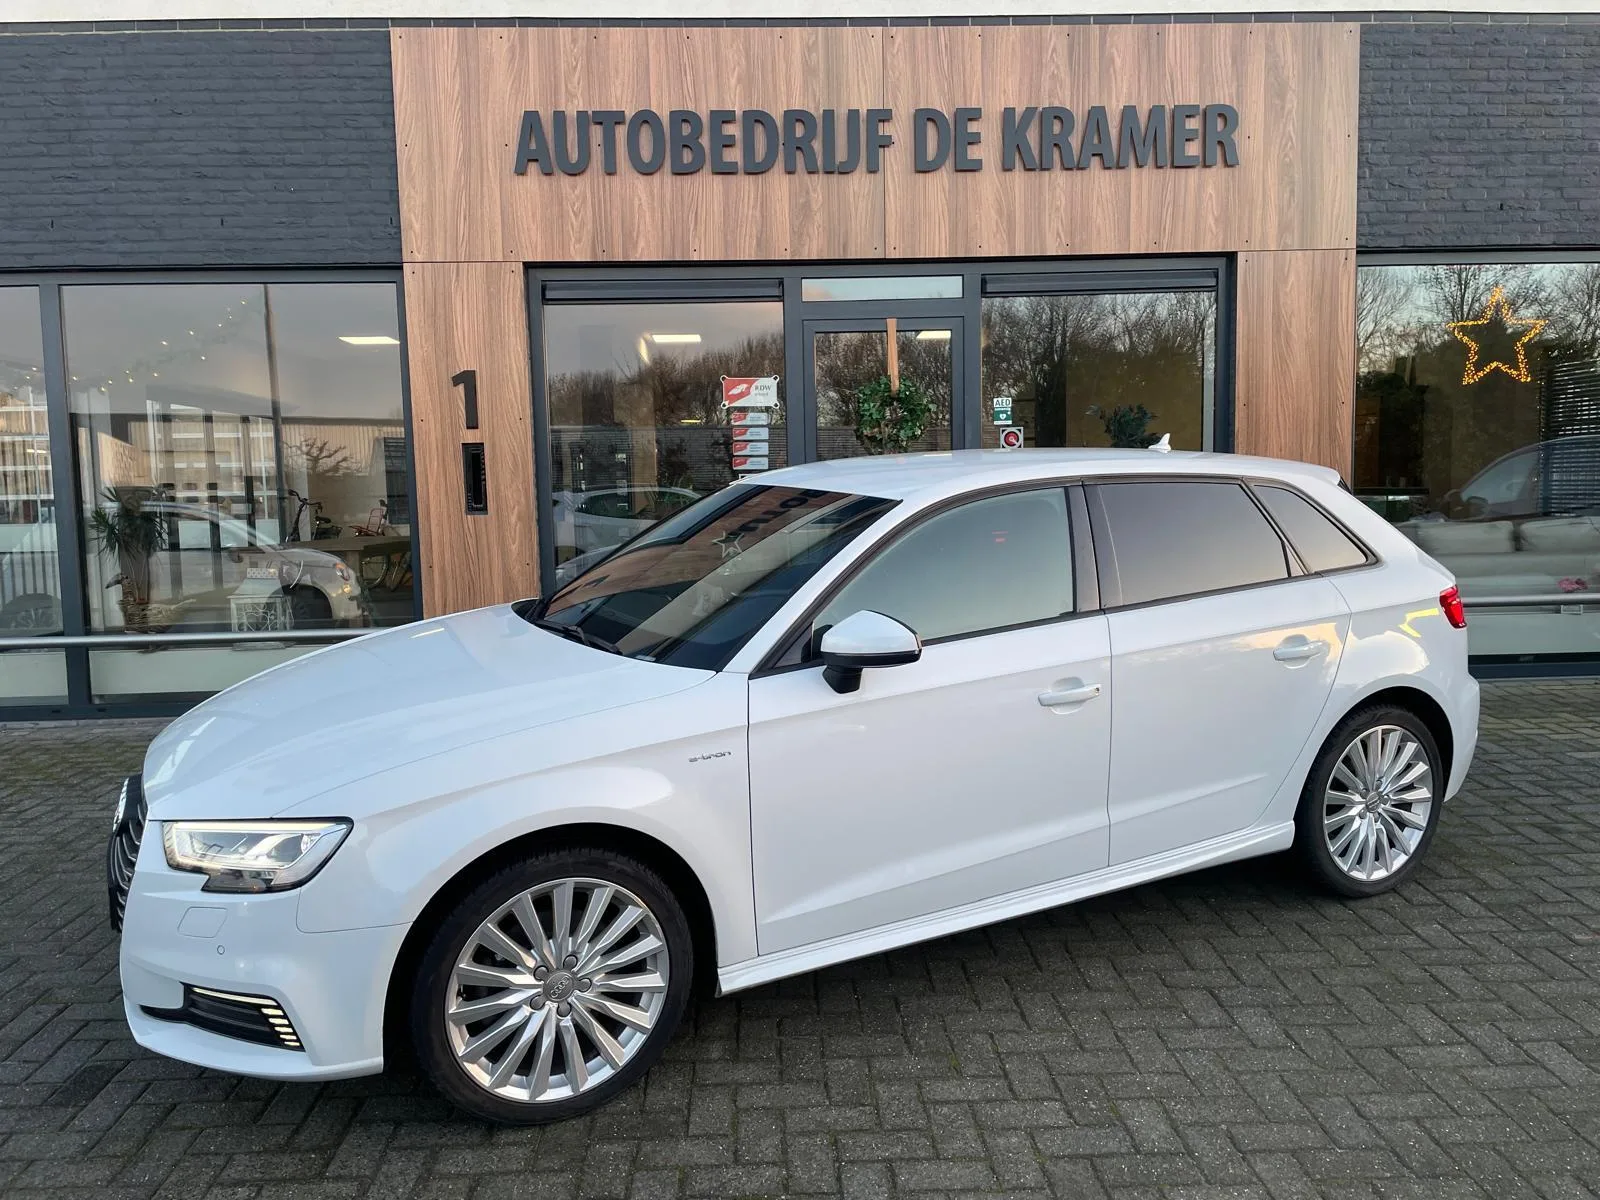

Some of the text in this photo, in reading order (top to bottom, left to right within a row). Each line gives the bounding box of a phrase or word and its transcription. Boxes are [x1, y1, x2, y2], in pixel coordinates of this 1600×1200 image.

[514, 103, 1239, 176] AUTOBEDRIJF DE KRAMER
[452, 370, 479, 429] 1
